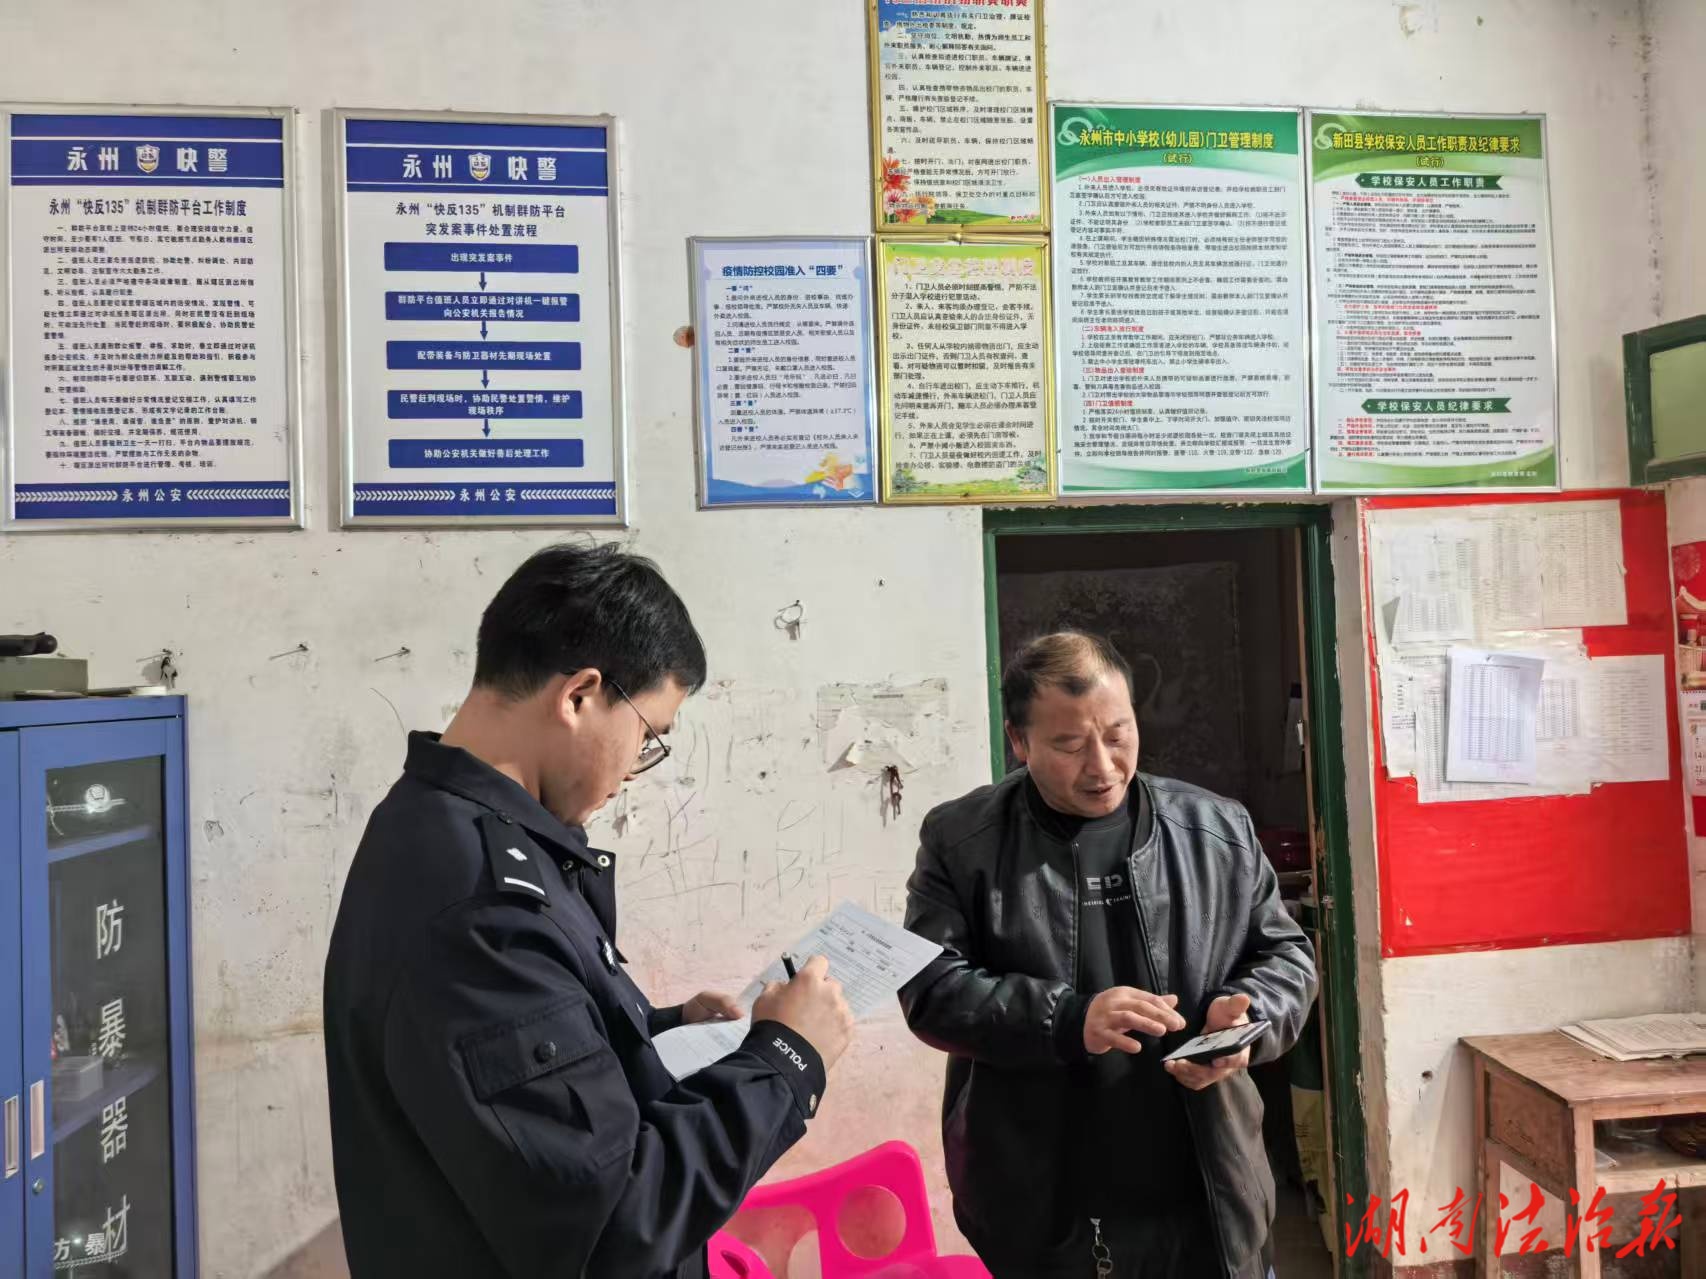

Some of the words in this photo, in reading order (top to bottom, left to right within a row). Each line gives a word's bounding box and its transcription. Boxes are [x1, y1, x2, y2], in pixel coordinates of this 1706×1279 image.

[1079, 129, 1275, 150] 永州市中小学校(幼儿园)门卫管理制度
[1333, 131, 1521, 153] 新田县学校保安人员工作职责及纪律要求
[66, 146, 119, 172] 永州
[177, 147, 228, 173] 快警
[1162, 152, 1193, 164] (试行)
[1416, 157, 1445, 168] (试行)
[402, 153, 452, 179] 永州
[508, 155, 557, 182] 快警
[1371, 175, 1485, 188] 学校保安人员工作职责
[396, 202, 566, 219] 永州“快反135”机制群防平台
[425, 222, 538, 238] 突发案事件处置流程
[450, 252, 513, 264] 出现突发案事件
[722, 264, 844, 277] 疫情防控校园准入“四要”
[398, 294, 568, 307] 群防平台值班人员立即通过对讲机一键报警
[443, 307, 525, 319] 向公安机关报告情况
[417, 350, 552, 362] 配带装备与防卫器材先期现场处置
[468, 405, 505, 416] 现场秩序
[1377, 400, 1495, 413] 学校保安人员纪律要求
[424, 448, 550, 459] 协助公安机关做好善后处理工作
[121, 488, 183, 503] 永州公安
[459, 488, 517, 503] 永州公安
[772, 1037, 808, 1072] POLICE
[96, 898, 131, 1261] 防暴器材
